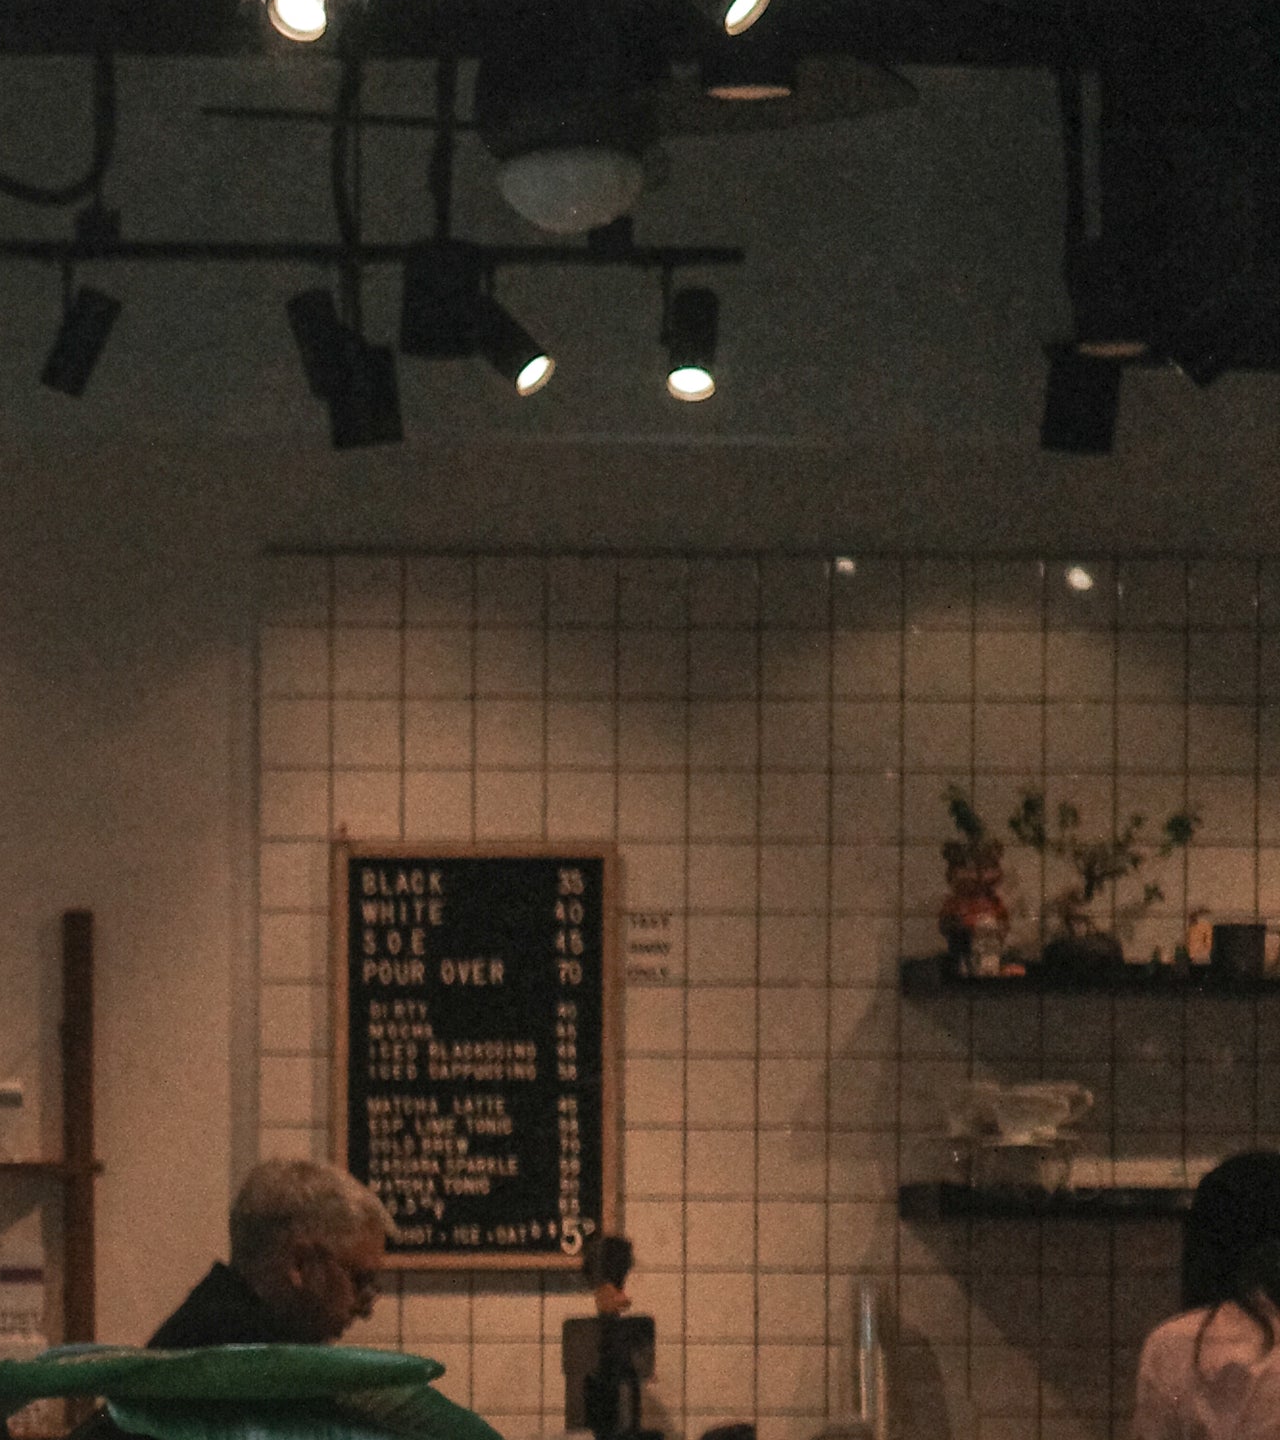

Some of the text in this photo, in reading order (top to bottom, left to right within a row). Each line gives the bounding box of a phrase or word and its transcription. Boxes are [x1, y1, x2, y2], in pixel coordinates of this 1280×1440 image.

[362, 868, 442, 895] BLACK
[361, 898, 442, 925] WHITE
[363, 959, 426, 986] POUR
[440, 959, 504, 986] OVER
[369, 999, 428, 1019] DIRTY
[369, 1022, 433, 1040] MOCHA
[369, 1040, 418, 1061] ICED
[369, 1062, 418, 1081] ICED
[367, 1096, 438, 1115] MATCHA
[453, 1096, 506, 1115] LATTE
[466, 1116, 513, 1136] TONIC
[443, 1177, 491, 1196] TONIC
